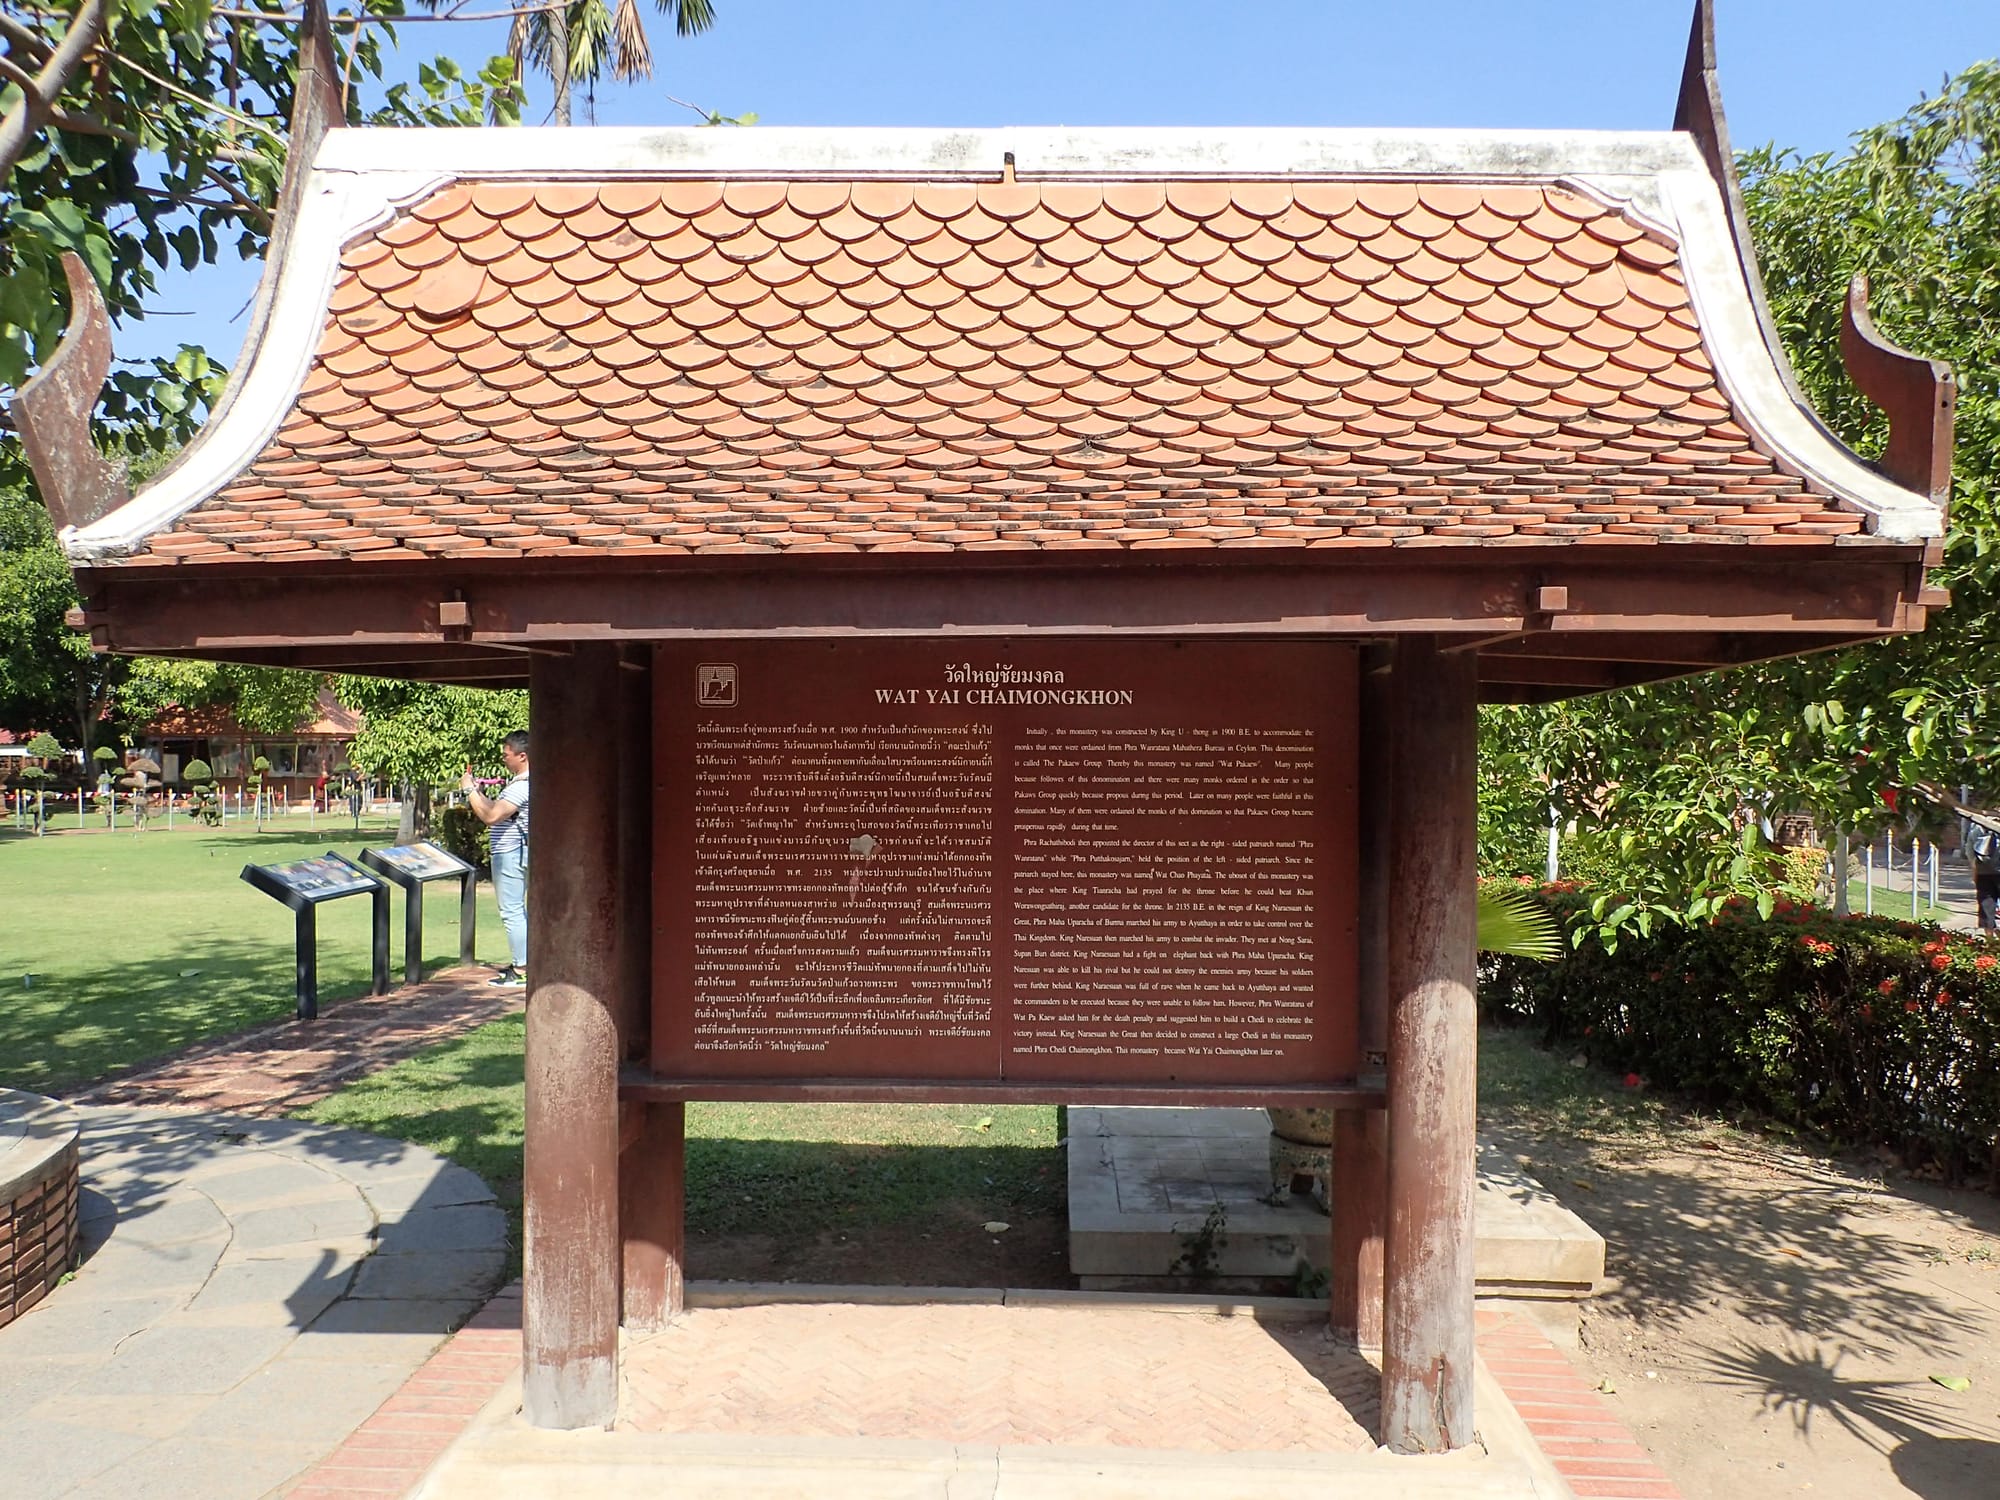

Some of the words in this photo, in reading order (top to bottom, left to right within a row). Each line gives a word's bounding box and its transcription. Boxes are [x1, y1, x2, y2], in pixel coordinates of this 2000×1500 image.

[944, 663, 1064, 688] วัดใหญ่ชัยมงคล
[874, 689, 919, 706] WAT
[926, 689, 960, 706] YAI
[966, 689, 1134, 706] CHAIMONGKHON
[1069, 728, 1098, 736] monastery
[1160, 728, 1175, 736] King
[1221, 728, 1236, 736] 1900
[1124, 743, 1137, 751] Phra
[1106, 759, 1130, 768] Thereby
[1147, 760, 1176, 768] monastery
[1274, 760, 1291, 769] Many
[1294, 760, 1314, 769] people
[1037, 790, 1056, 800] Group
[1058, 791, 1080, 800] quickly
[1234, 792, 1253, 800] people
[1049, 806, 1066, 814] Many
[1270, 808, 1290, 816] Group
[1050, 854, 1066, 862] while
[1215, 855, 1226, 863] left
[1040, 870, 1059, 879] stayed
[1214, 871, 1226, 879] The
[1270, 873, 1300, 881] monastery
[1028, 886, 1044, 895] place
[1049, 886, 1067, 894] where
[1072, 886, 1087, 895] King
[1142, 887, 1163, 896] prayed
[1196, 887, 1215, 895] throne
[1220, 887, 1239, 895] before
[1296, 888, 1314, 896] Khun
[1068, 902, 1090, 910] another
[1092, 902, 1119, 910] candidate
[1175, 903, 1190, 911] 2135
[1254, 903, 1269, 912] King
[1048, 918, 1065, 926] Maha
[1125, 918, 1150, 926] marched
[1162, 920, 1178, 928] army
[1227, 919, 1243, 927] order
[1266, 919, 1287, 927] control
[1013, 933, 1027, 941] Thai
[1059, 934, 1074, 943] King
[1118, 934, 1143, 942] marched
[1155, 936, 1171, 944] army
[1180, 935, 1202, 943] combat
[1240, 935, 1255, 944] They
[1278, 936, 1295, 945] Nong
[1142, 950, 1156, 959] fight
[1172, 951, 1197, 960] elephant
[1199, 951, 1213, 959] back
[1231, 951, 1245, 959] Phra
[1247, 951, 1265, 959] Maha
[1105, 966, 1118, 974] rival
[1143, 966, 1160, 974] could
[1174, 967, 1195, 976] destroy
[1236, 968, 1252, 976] army
[1254, 967, 1277, 975] because
[1030, 981, 1049, 989] further
[1075, 982, 1090, 991] King
[1138, 982, 1149, 990] full
[1258, 999, 1272, 1007] Phra
[1132, 1014, 1154, 1023] penalty
[1169, 1015, 1197, 1024] suggested
[1223, 1015, 1238, 1023] build
[1247, 1015, 1264, 1023] Chedi
[1012, 1030, 1033, 1038] victory
[1060, 1029, 1074, 1039] King
[1155, 1030, 1178, 1038] decided
[1224, 1031, 1239, 1040] large
[1241, 1031, 1259, 1039] Chedi
[1283, 1032, 1313, 1041] monastery
[1034, 1045, 1048, 1053] Phra
[1049, 1045, 1066, 1053] Chedi
[1129, 1047, 1159, 1055] monastery
[1187, 1046, 1200, 1054] Wat
[1260, 1047, 1273, 1055] later
